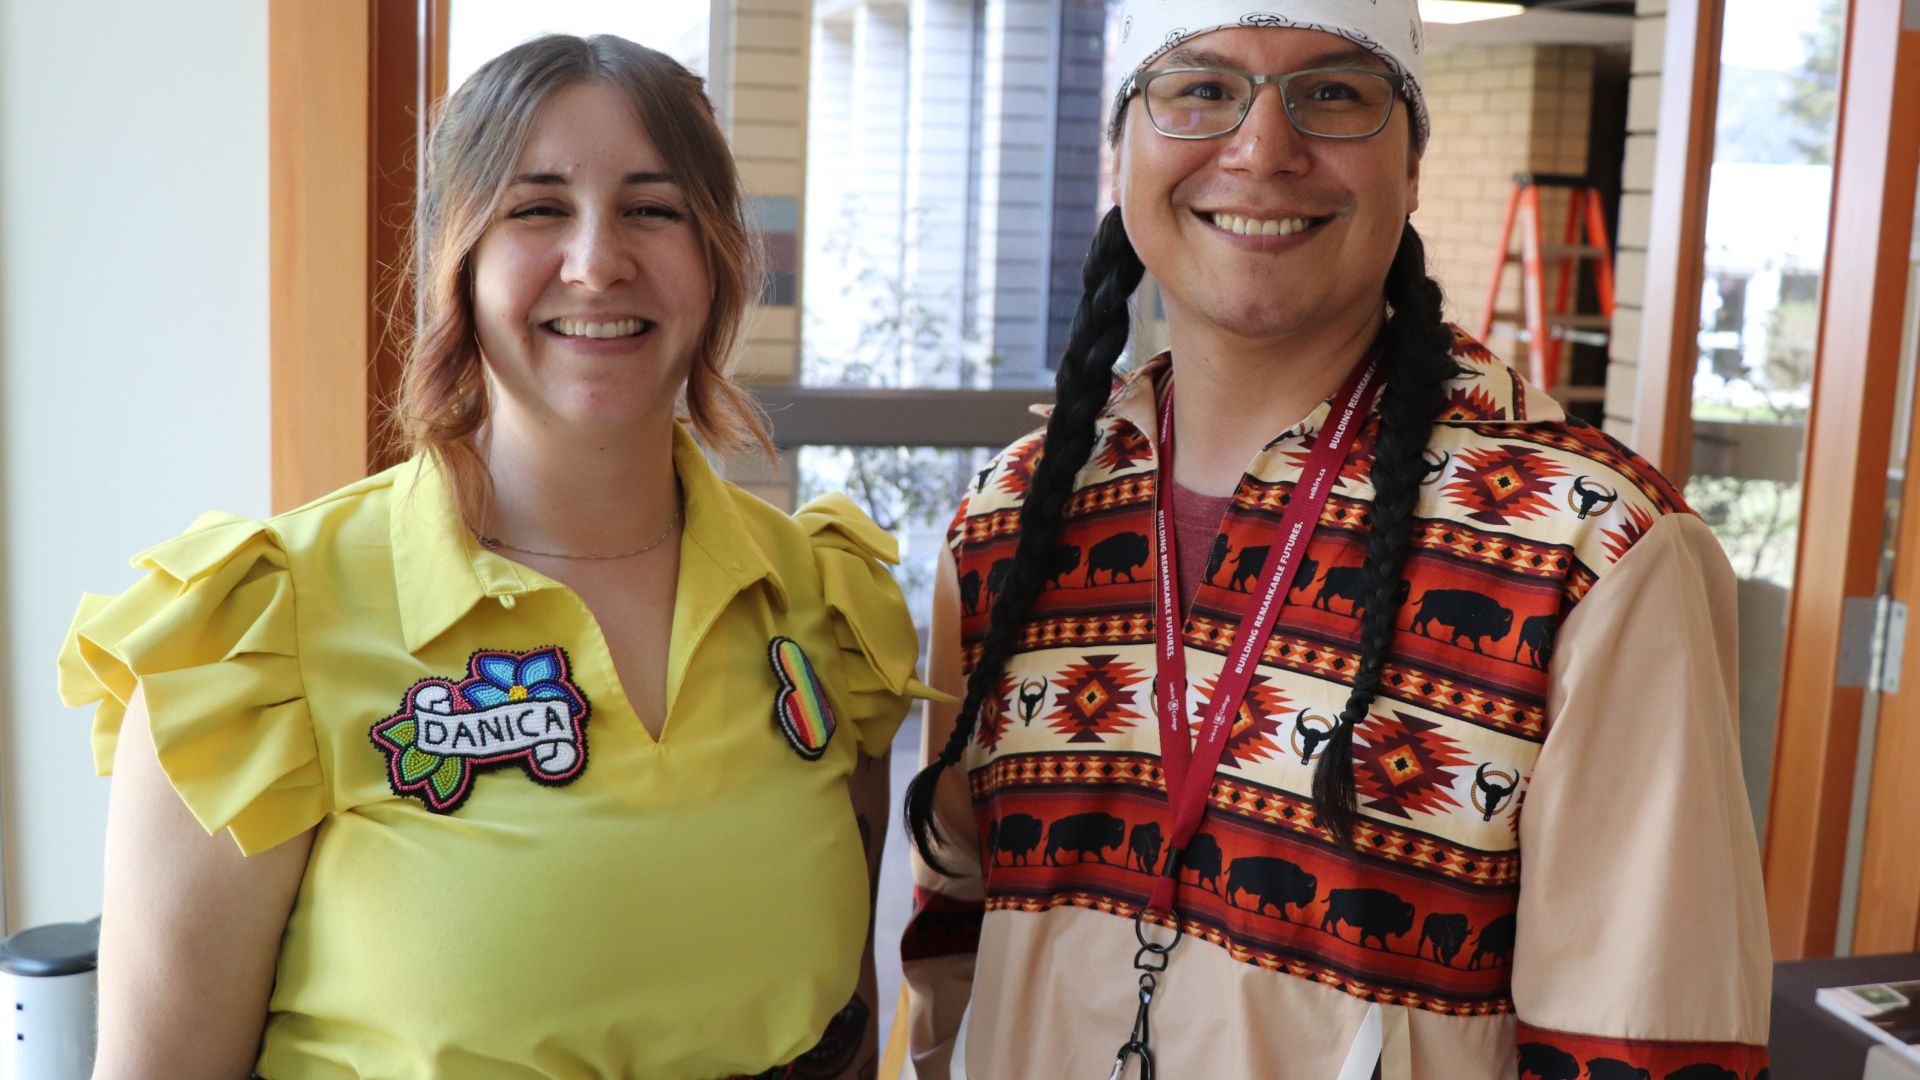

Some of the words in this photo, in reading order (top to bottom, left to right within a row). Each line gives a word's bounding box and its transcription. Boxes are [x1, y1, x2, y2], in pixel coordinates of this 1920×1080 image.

[1328, 408, 1353, 450] BUILDING
[1309, 468, 1326, 500] selkirk.ca
[1157, 509, 1168, 553] BUILDING
[1160, 554, 1172, 616] REMARKABLE
[1235, 628, 1259, 674] BUILDING
[1253, 564, 1286, 628] REMARKABLE
[1280, 521, 1304, 565] FUTURES.
[1165, 616, 1175, 660] FUTURES.
[424, 705, 565, 749] DANICA
